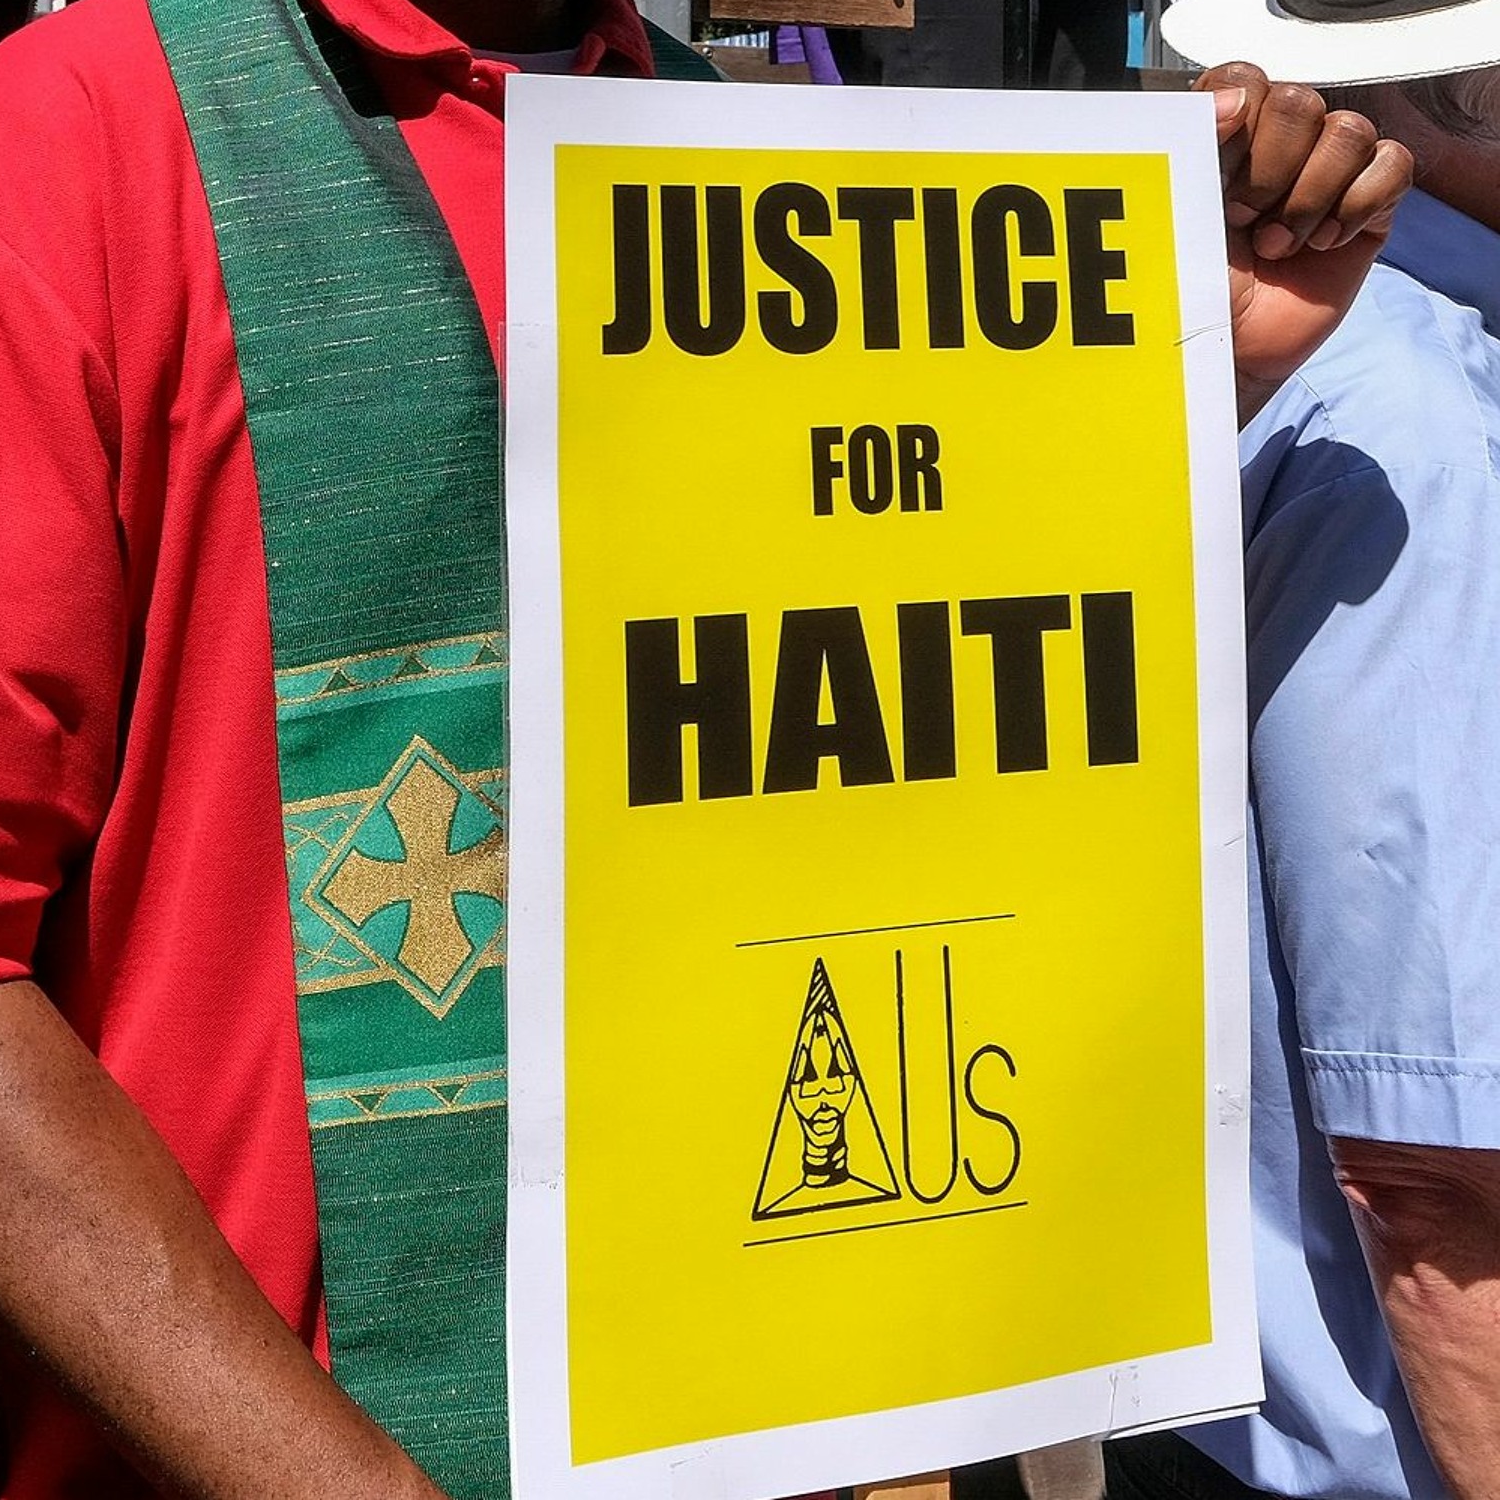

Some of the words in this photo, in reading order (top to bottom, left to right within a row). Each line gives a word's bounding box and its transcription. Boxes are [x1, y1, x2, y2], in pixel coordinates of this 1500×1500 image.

[602, 182, 1136, 357] JUSTICE
[810, 424, 943, 516] FOR
[624, 591, 1140, 808] HAITI
